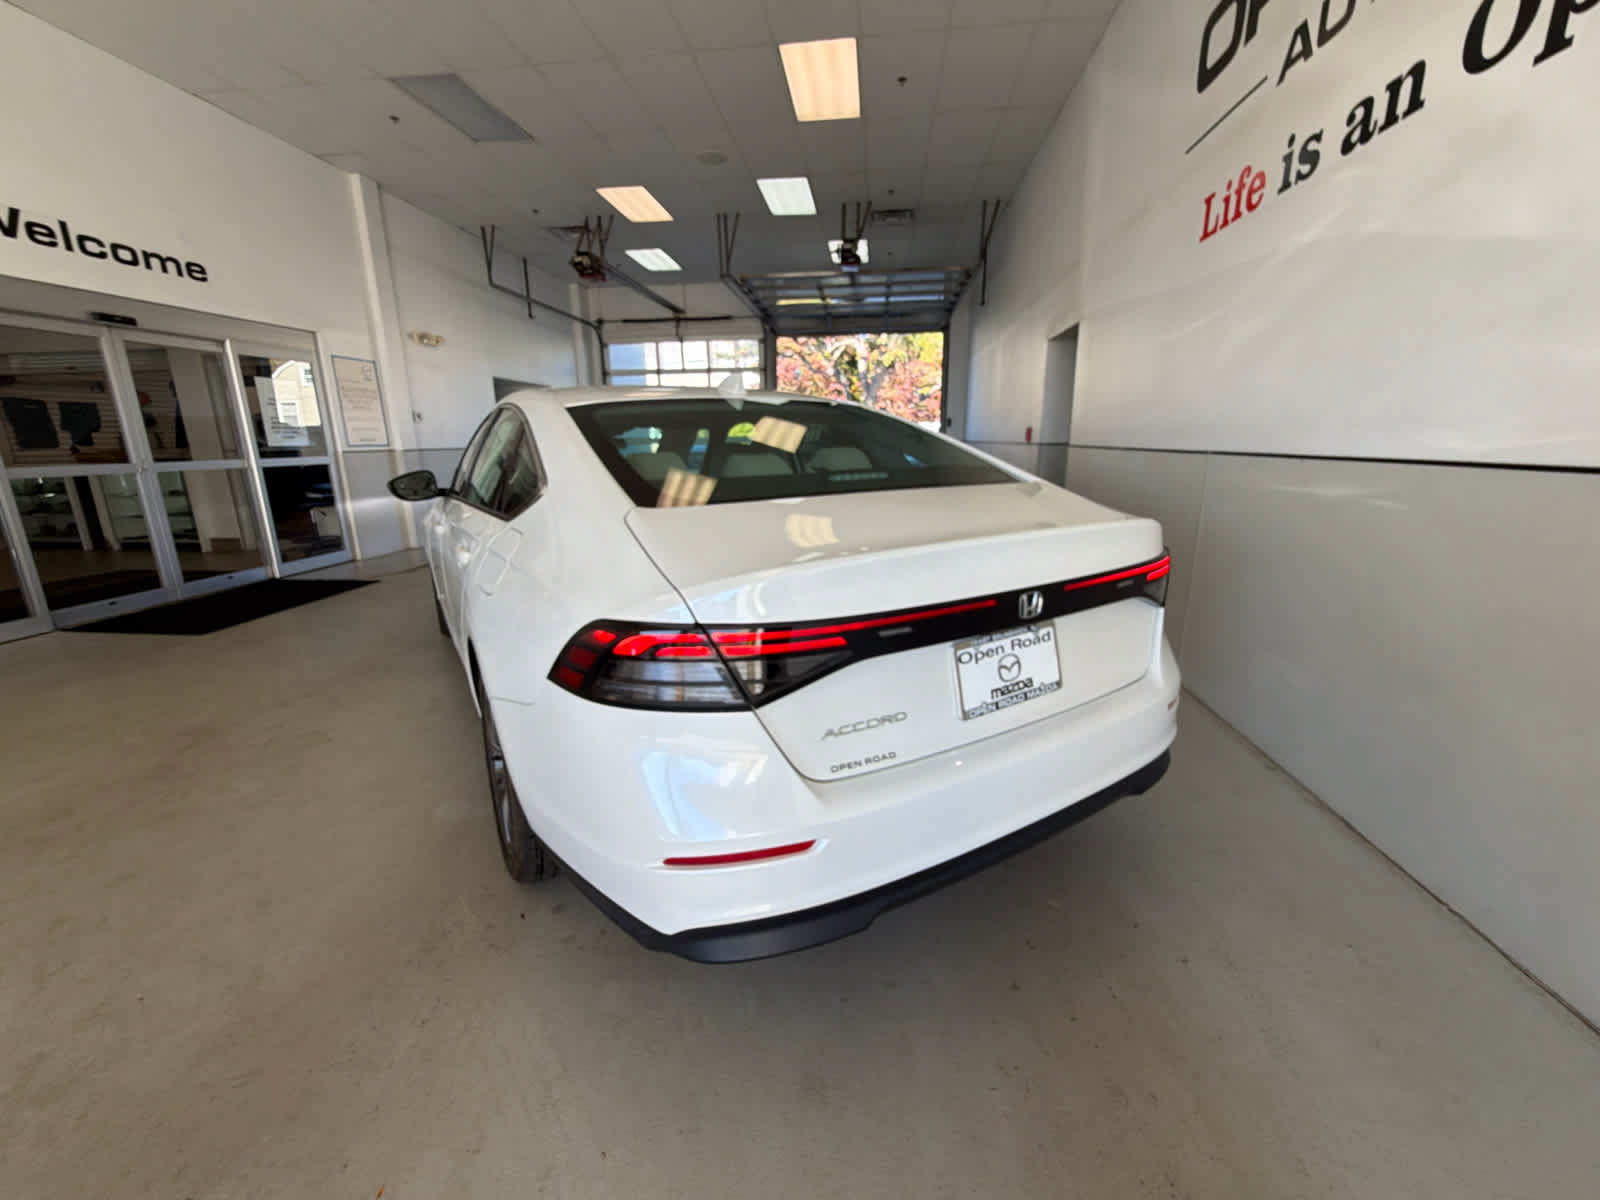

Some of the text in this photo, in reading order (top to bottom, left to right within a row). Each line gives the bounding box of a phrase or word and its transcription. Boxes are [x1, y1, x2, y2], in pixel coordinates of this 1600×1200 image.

[1199, 164, 1266, 243] Life
[1277, 129, 1324, 195] is
[1340, 59, 1427, 156] an
[958, 645, 1005, 664] Open
[1011, 630, 1051, 651] Road
[991, 678, 1034, 699] mazda
[822, 712, 907, 740] ACCORD
[831, 752, 896, 773] OPEN ROAD
